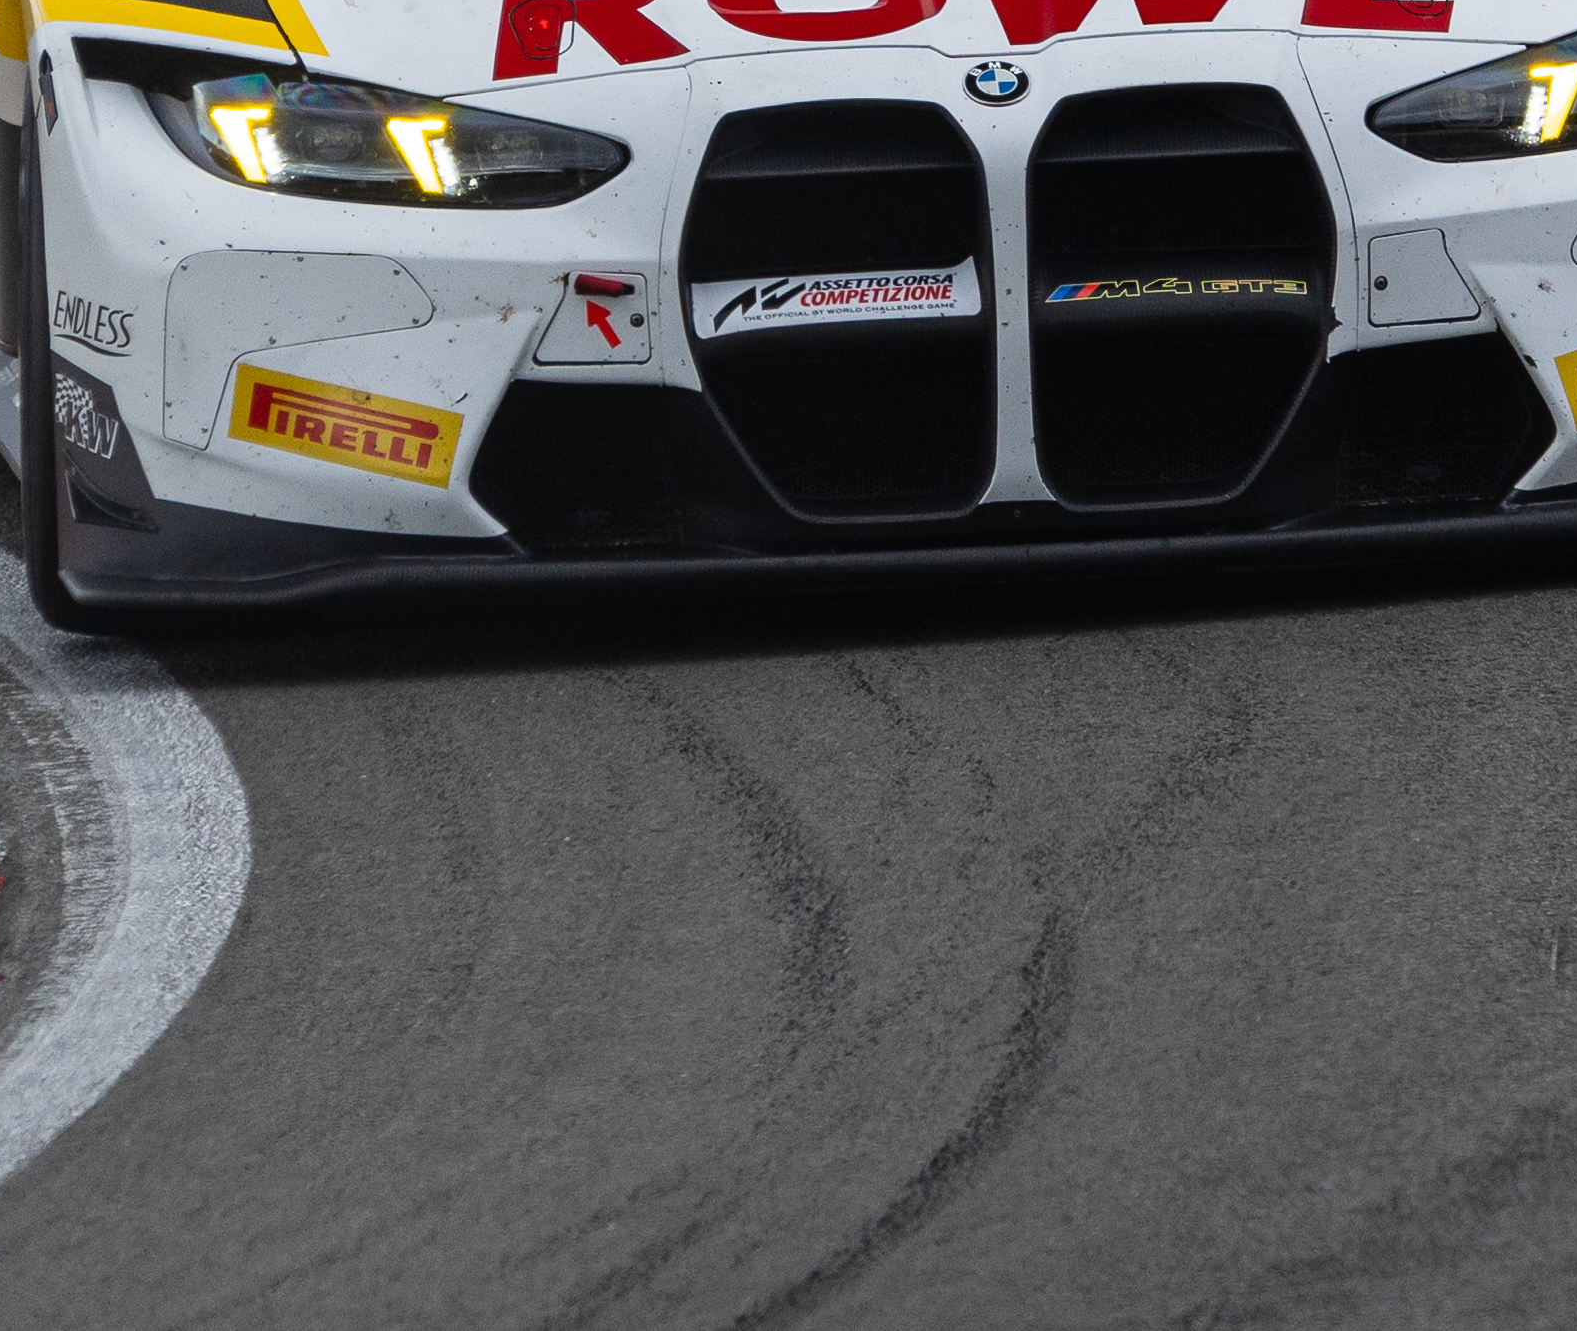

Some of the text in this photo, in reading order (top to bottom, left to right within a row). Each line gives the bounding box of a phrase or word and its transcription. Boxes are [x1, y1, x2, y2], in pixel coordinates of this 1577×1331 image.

[969, 62, 1023, 77] BMW
[809, 273, 954, 292] ASSETTO CORSA
[1092, 277, 1307, 299] M4 GT3
[800, 283, 954, 307] COMPETIZIONE
[53, 290, 134, 349] ENDLESS
[743, 300, 955, 323] THE OFFICIAL GT WORLD CHALLENGE GAME
[64, 400, 119, 460] KW
[248, 381, 440, 469] PIRELLI
